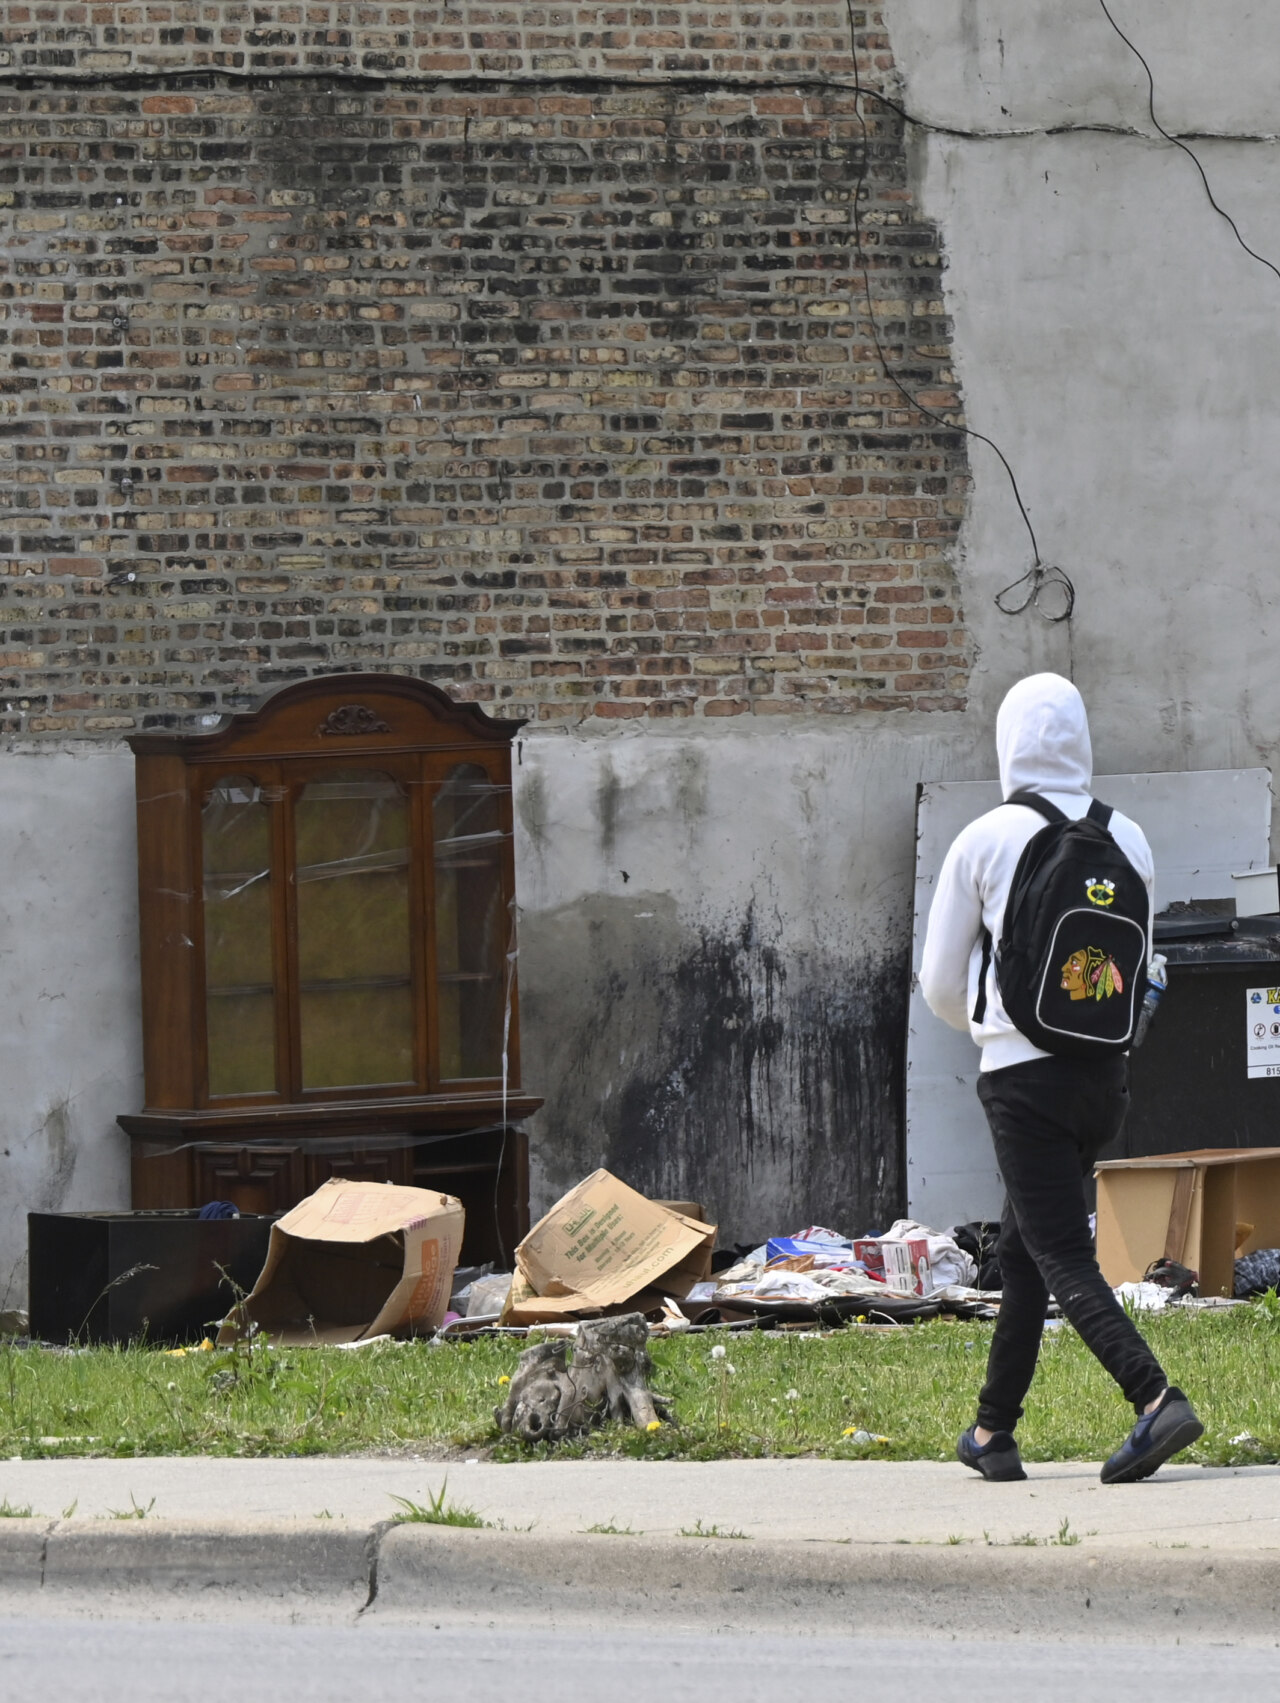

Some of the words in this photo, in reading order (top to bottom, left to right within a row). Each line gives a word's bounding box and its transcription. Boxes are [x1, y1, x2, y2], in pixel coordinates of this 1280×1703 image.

[1250, 1043, 1267, 1051] Cooking
[565, 1207, 591, 1232] U-UL
[565, 1246, 579, 1259] This
[577, 1235, 590, 1247] Box
[591, 1226, 596, 1234] is
[594, 1203, 619, 1229] Designed
[577, 1251, 587, 1262] for
[585, 1229, 609, 1253] Multiple
